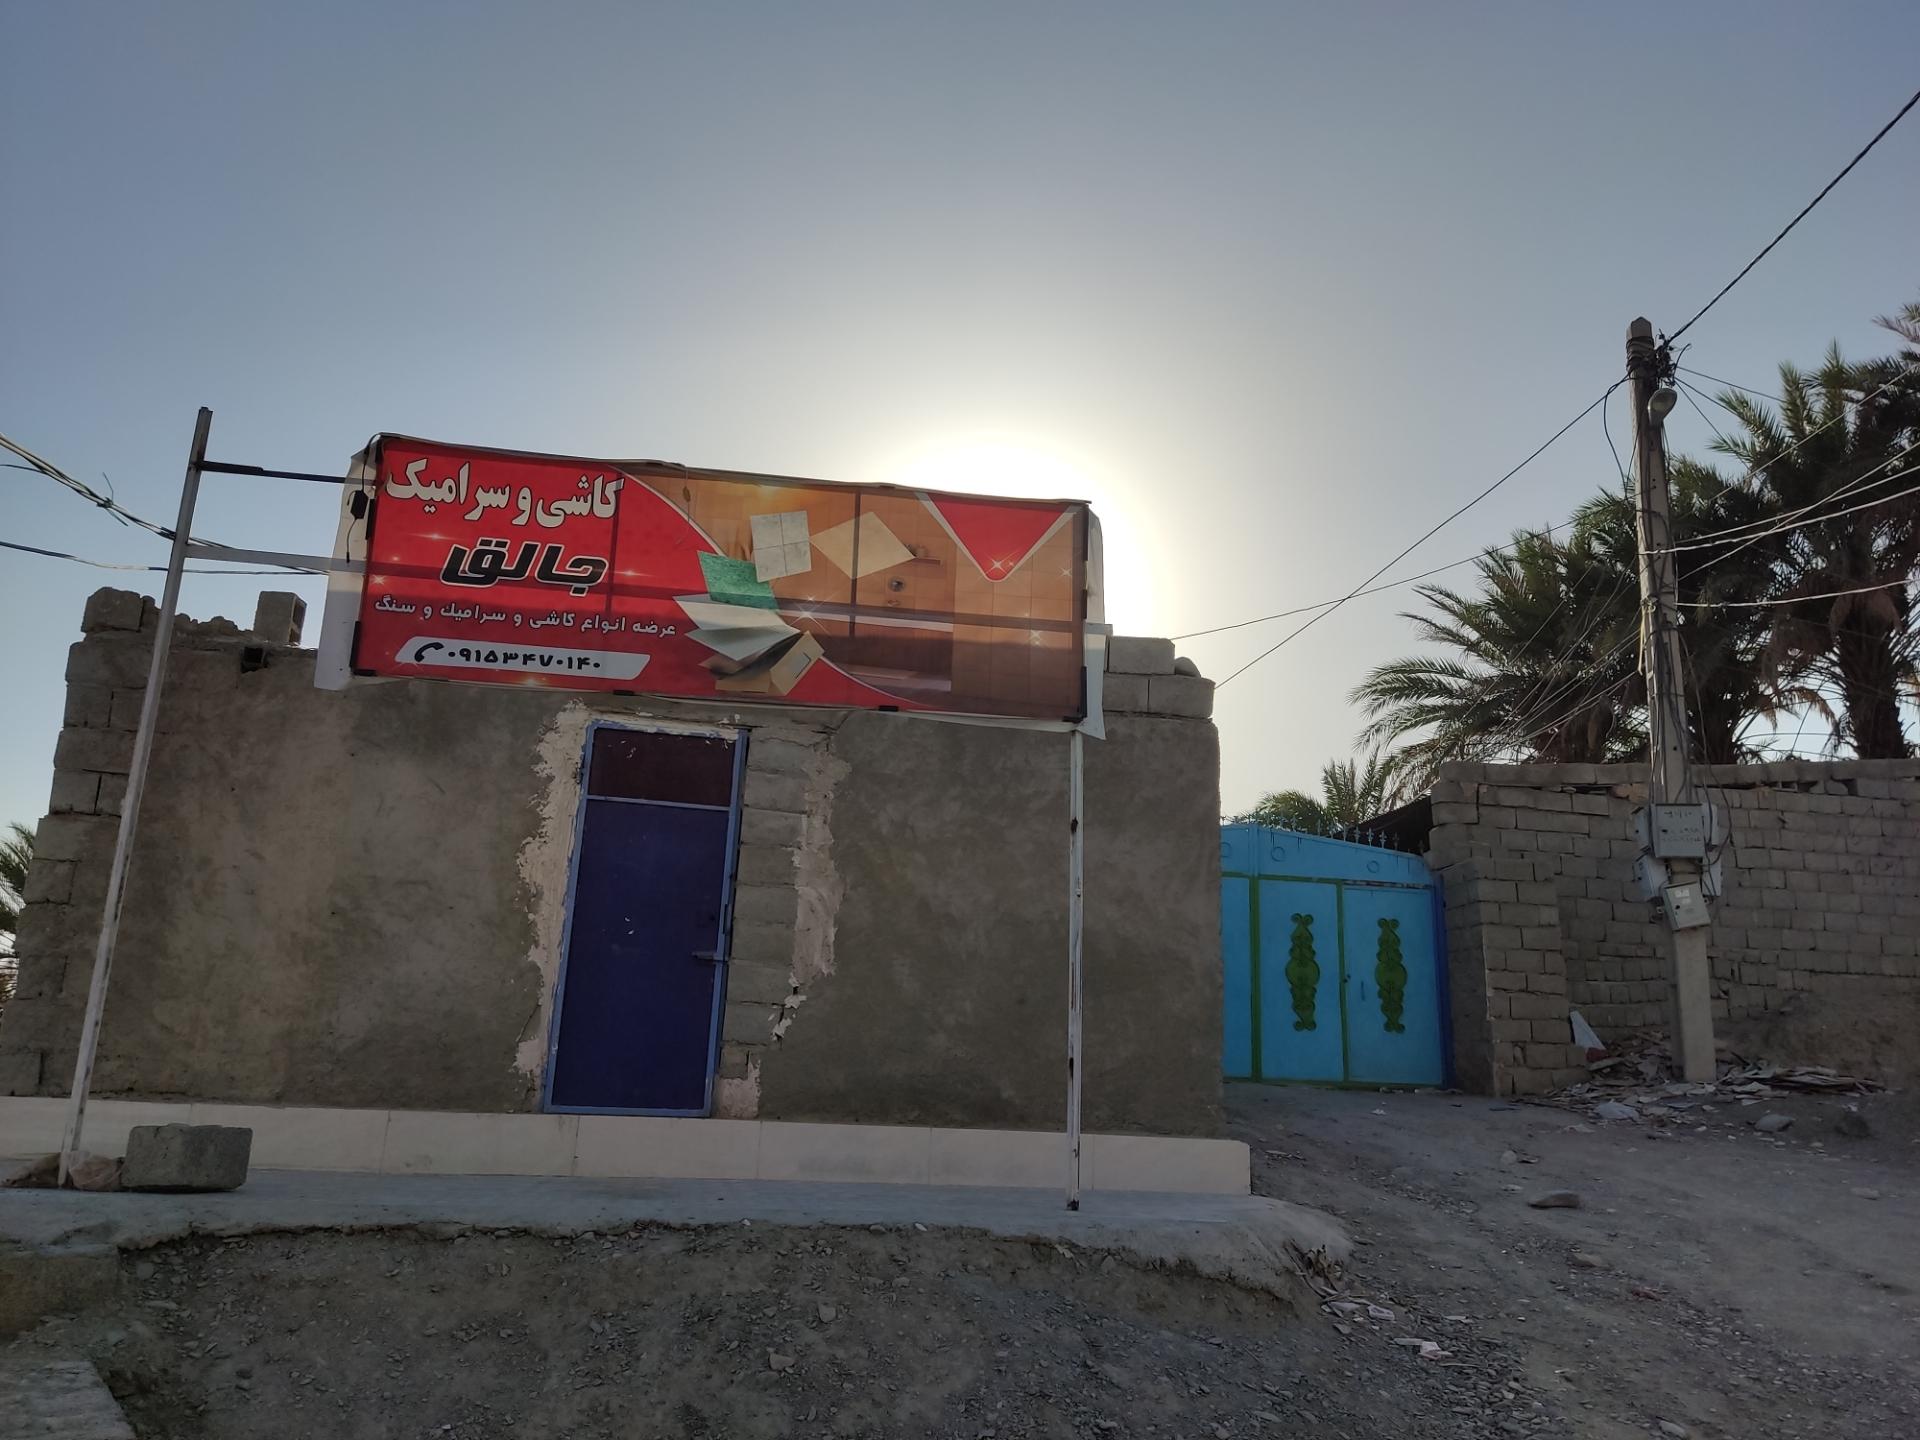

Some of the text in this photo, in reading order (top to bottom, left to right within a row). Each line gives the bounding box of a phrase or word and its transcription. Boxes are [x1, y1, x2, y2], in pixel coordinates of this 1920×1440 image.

[386, 459, 625, 528] کاشی و سرامیک
[440, 537, 609, 597] جالق
[375, 594, 416, 614] سنگ
[423, 605, 432, 620] و
[513, 612, 522, 627] و
[529, 610, 575, 629] کاشی
[581, 614, 626, 634] انواع
[632, 620, 676, 638] عرضه
[448, 647, 601, 671] ۰۹۱۵۳۴۷۰۱۴۰
